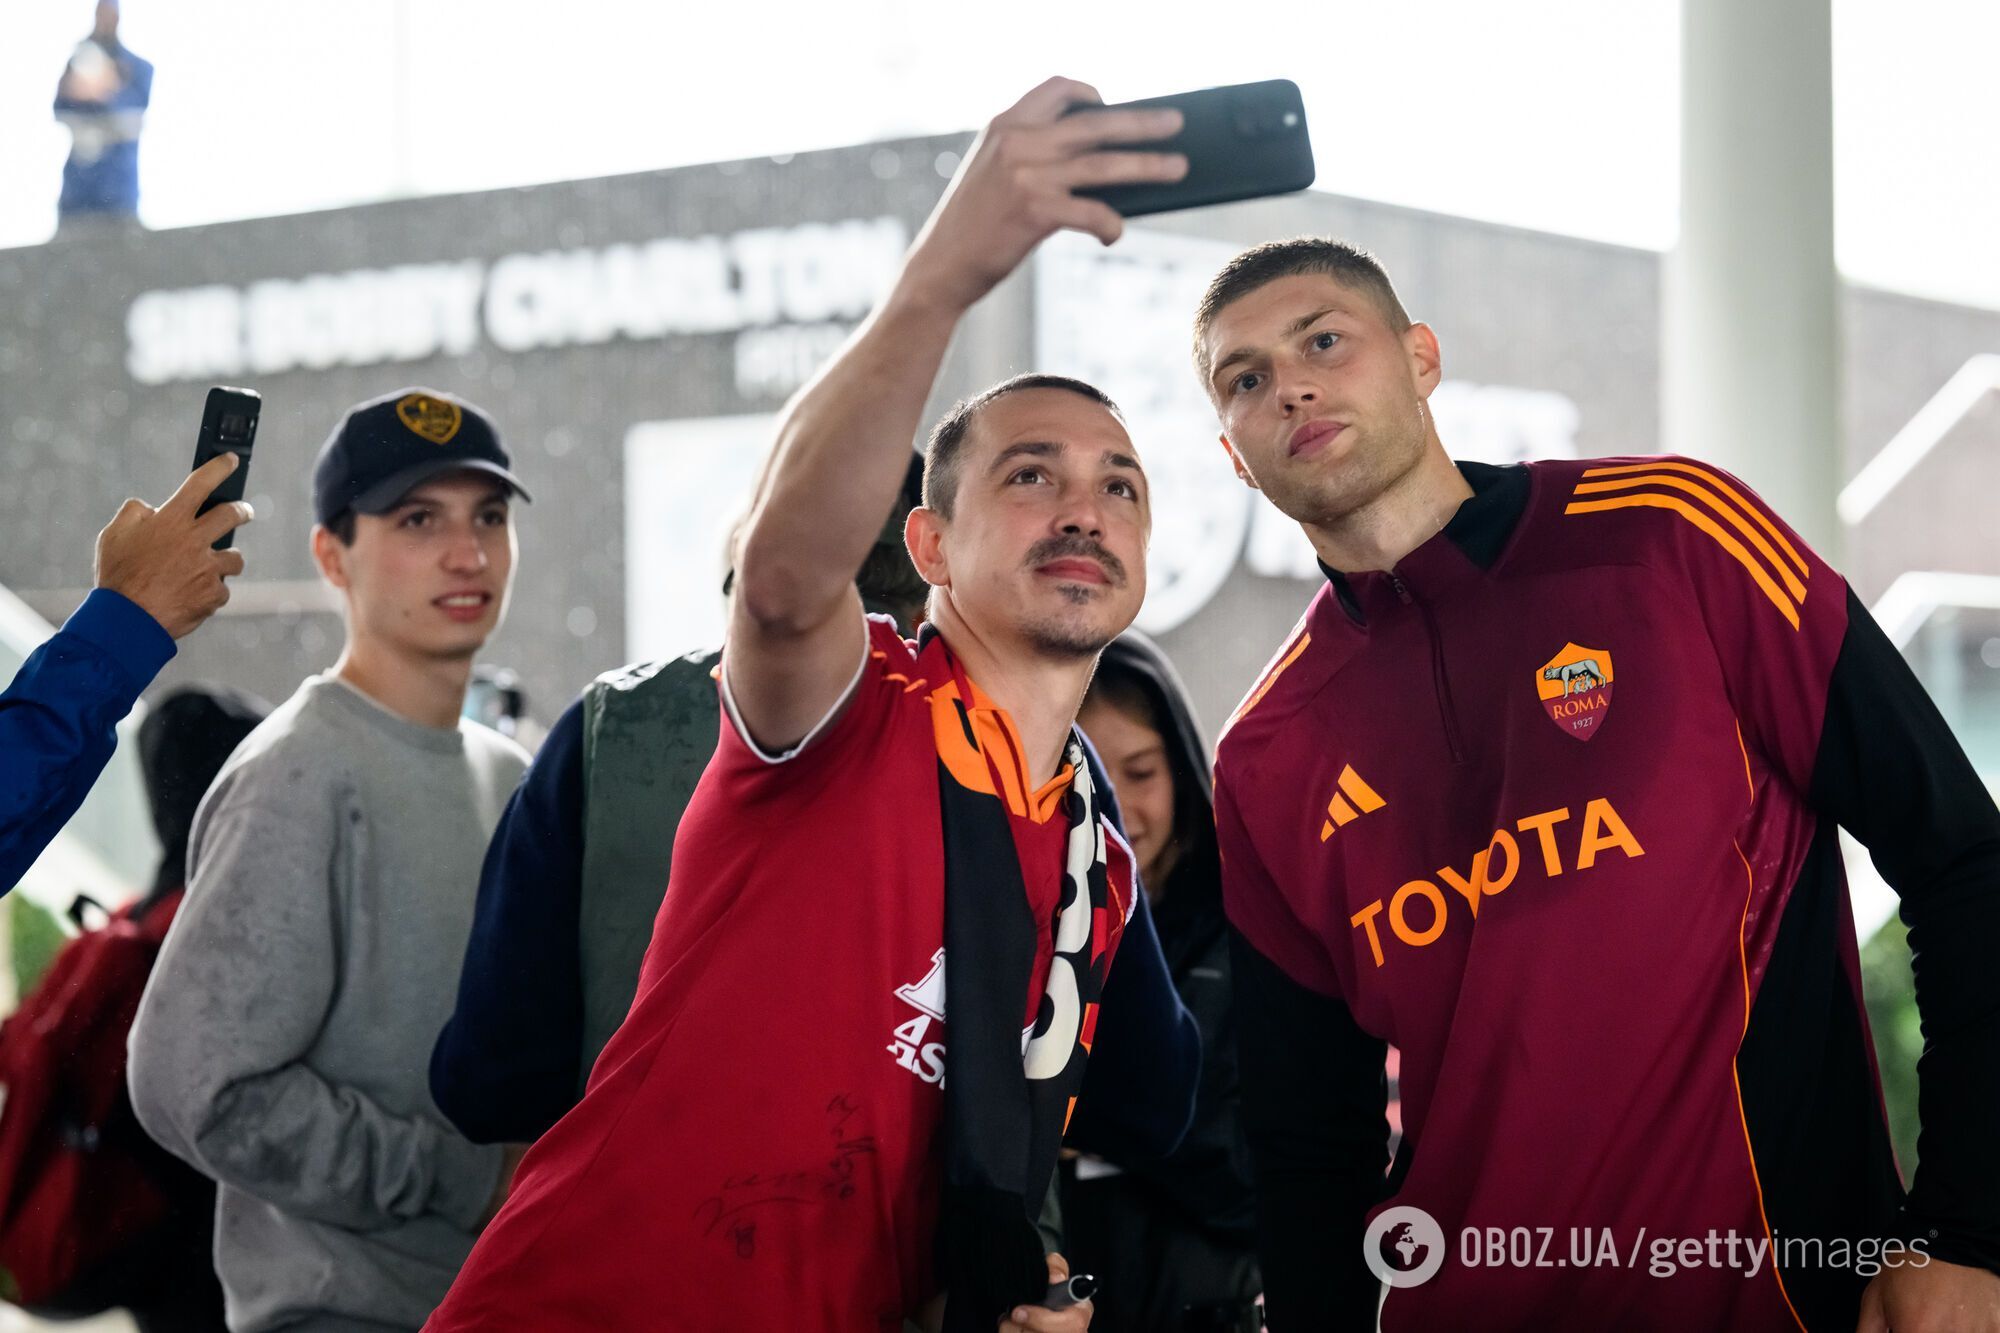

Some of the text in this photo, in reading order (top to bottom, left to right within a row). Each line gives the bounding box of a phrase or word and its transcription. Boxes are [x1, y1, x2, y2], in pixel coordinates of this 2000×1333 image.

[1553, 693, 1608, 720] ROMA
[1572, 716, 1593, 730] 1927
[1350, 797, 1646, 968] TOYOTA
